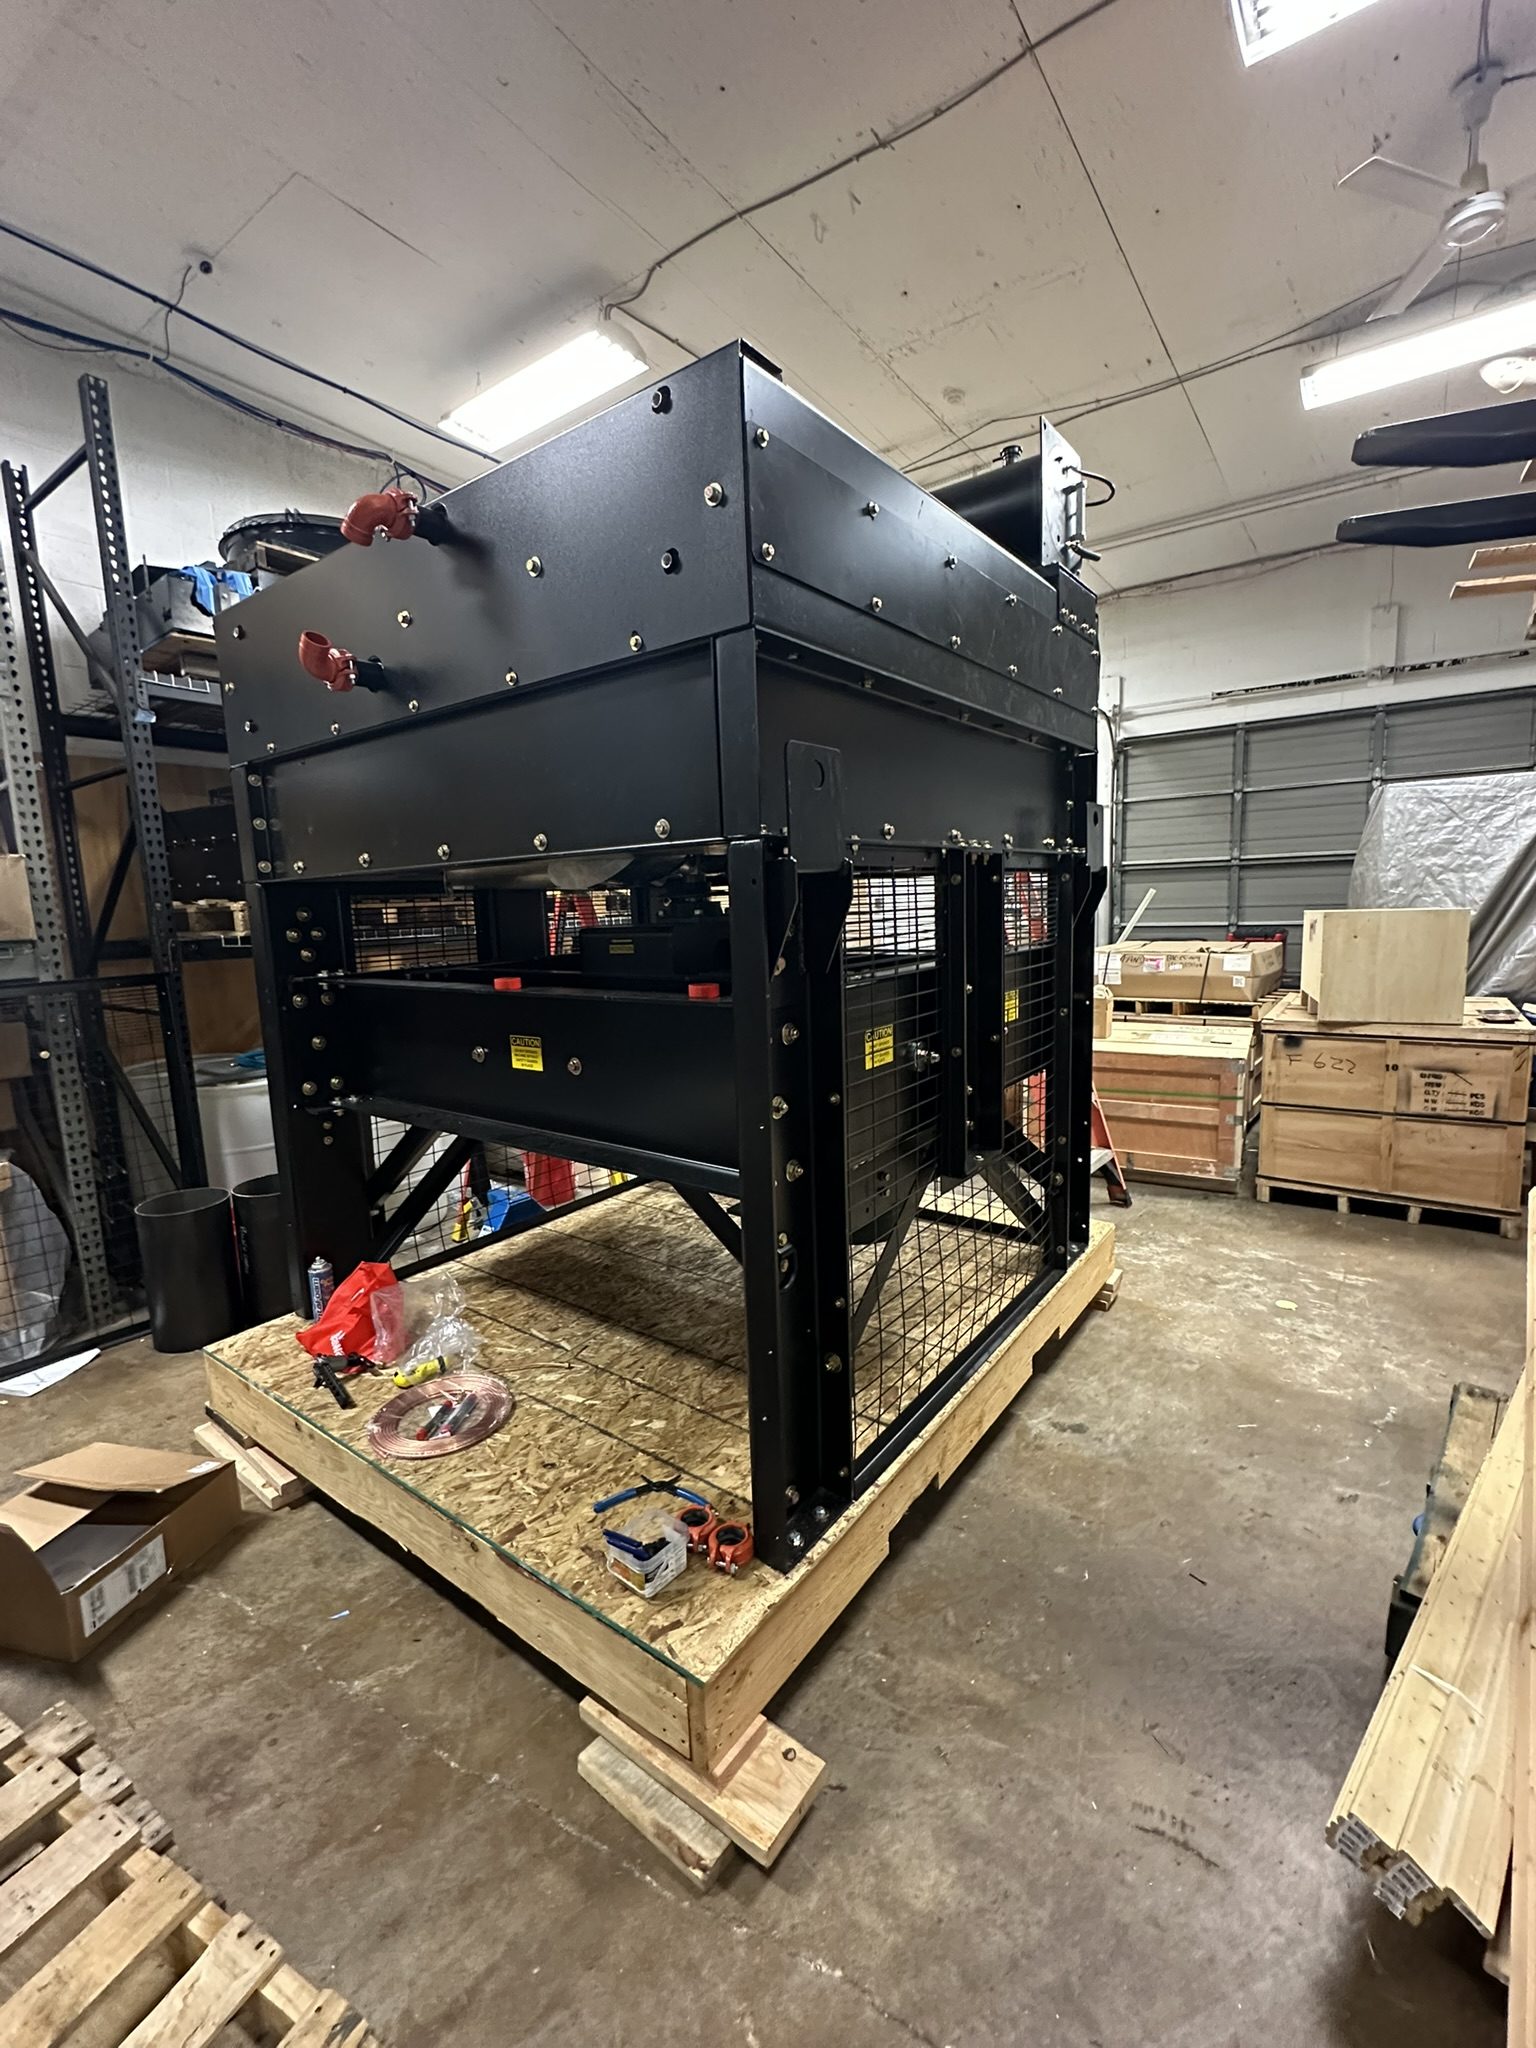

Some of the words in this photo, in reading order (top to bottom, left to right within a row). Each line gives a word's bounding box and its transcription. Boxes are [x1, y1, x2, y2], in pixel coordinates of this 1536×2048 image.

[511, 1037, 540, 1047] CAUTION
[1286, 1054, 1302, 1066] F
[1313, 1052, 1356, 1075] 622
[1385, 1064, 1399, 1072] 10
